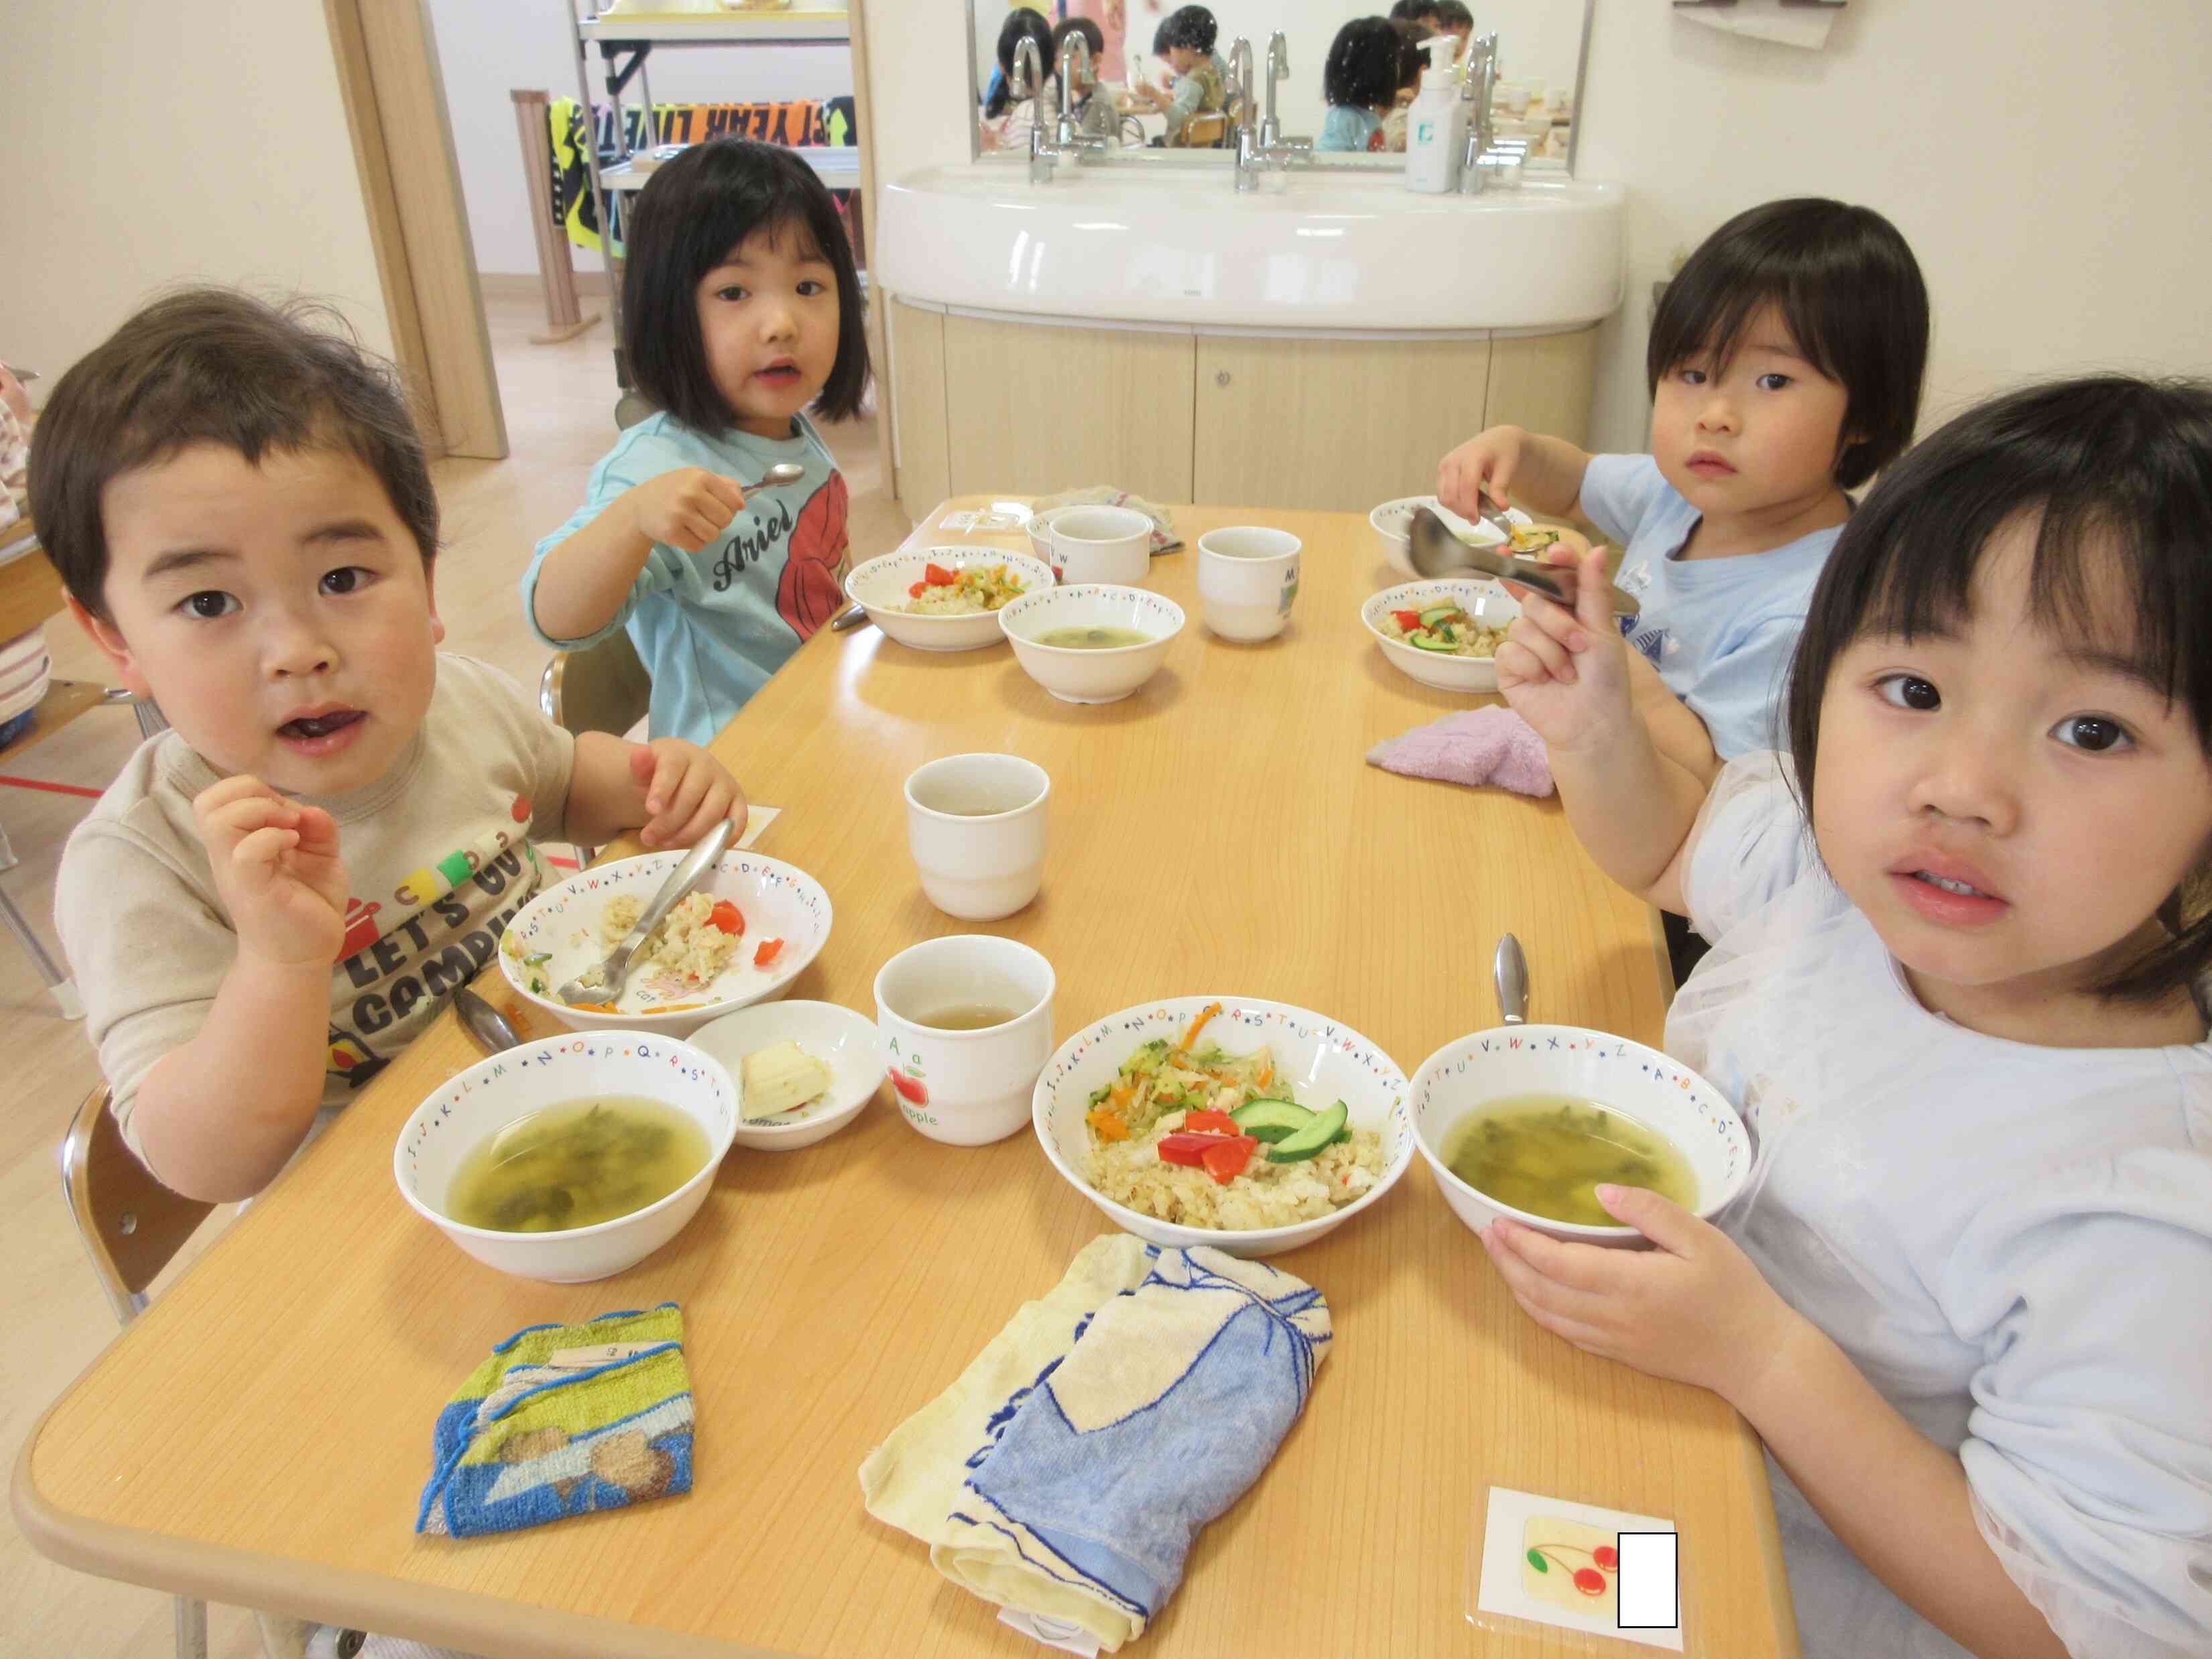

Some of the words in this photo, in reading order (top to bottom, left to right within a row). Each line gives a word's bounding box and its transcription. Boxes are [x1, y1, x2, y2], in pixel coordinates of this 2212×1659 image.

[713, 499, 793, 592] Ariel
[587, 879, 599, 889] W
[611, 870, 623, 882] X
[741, 863, 750, 873] D
[343, 892, 469, 989] LET'S
[889, 1036, 900, 1056] A
[1070, 1052, 1080, 1065] K
[1132, 1017, 1145, 1032] N
[1156, 1009, 1166, 1020] O
[1254, 1014, 1264, 1027] S
[1278, 1013, 1288, 1025] T
[1362, 1052, 1373, 1066] X
[440, 1104, 452, 1117] K
[536, 1050, 552, 1066] N
[572, 1040, 585, 1053] O
[637, 1045, 651, 1058] Q
[1481, 1039, 1489, 1052] V
[1509, 1037, 1523, 1050] W
[1547, 1036, 1560, 1050] X
[1615, 1044, 1626, 1057] Z
[1654, 1068, 1663, 1081] A
[1680, 1077, 1691, 1089] B
[1718, 1120, 1726, 1133] D
